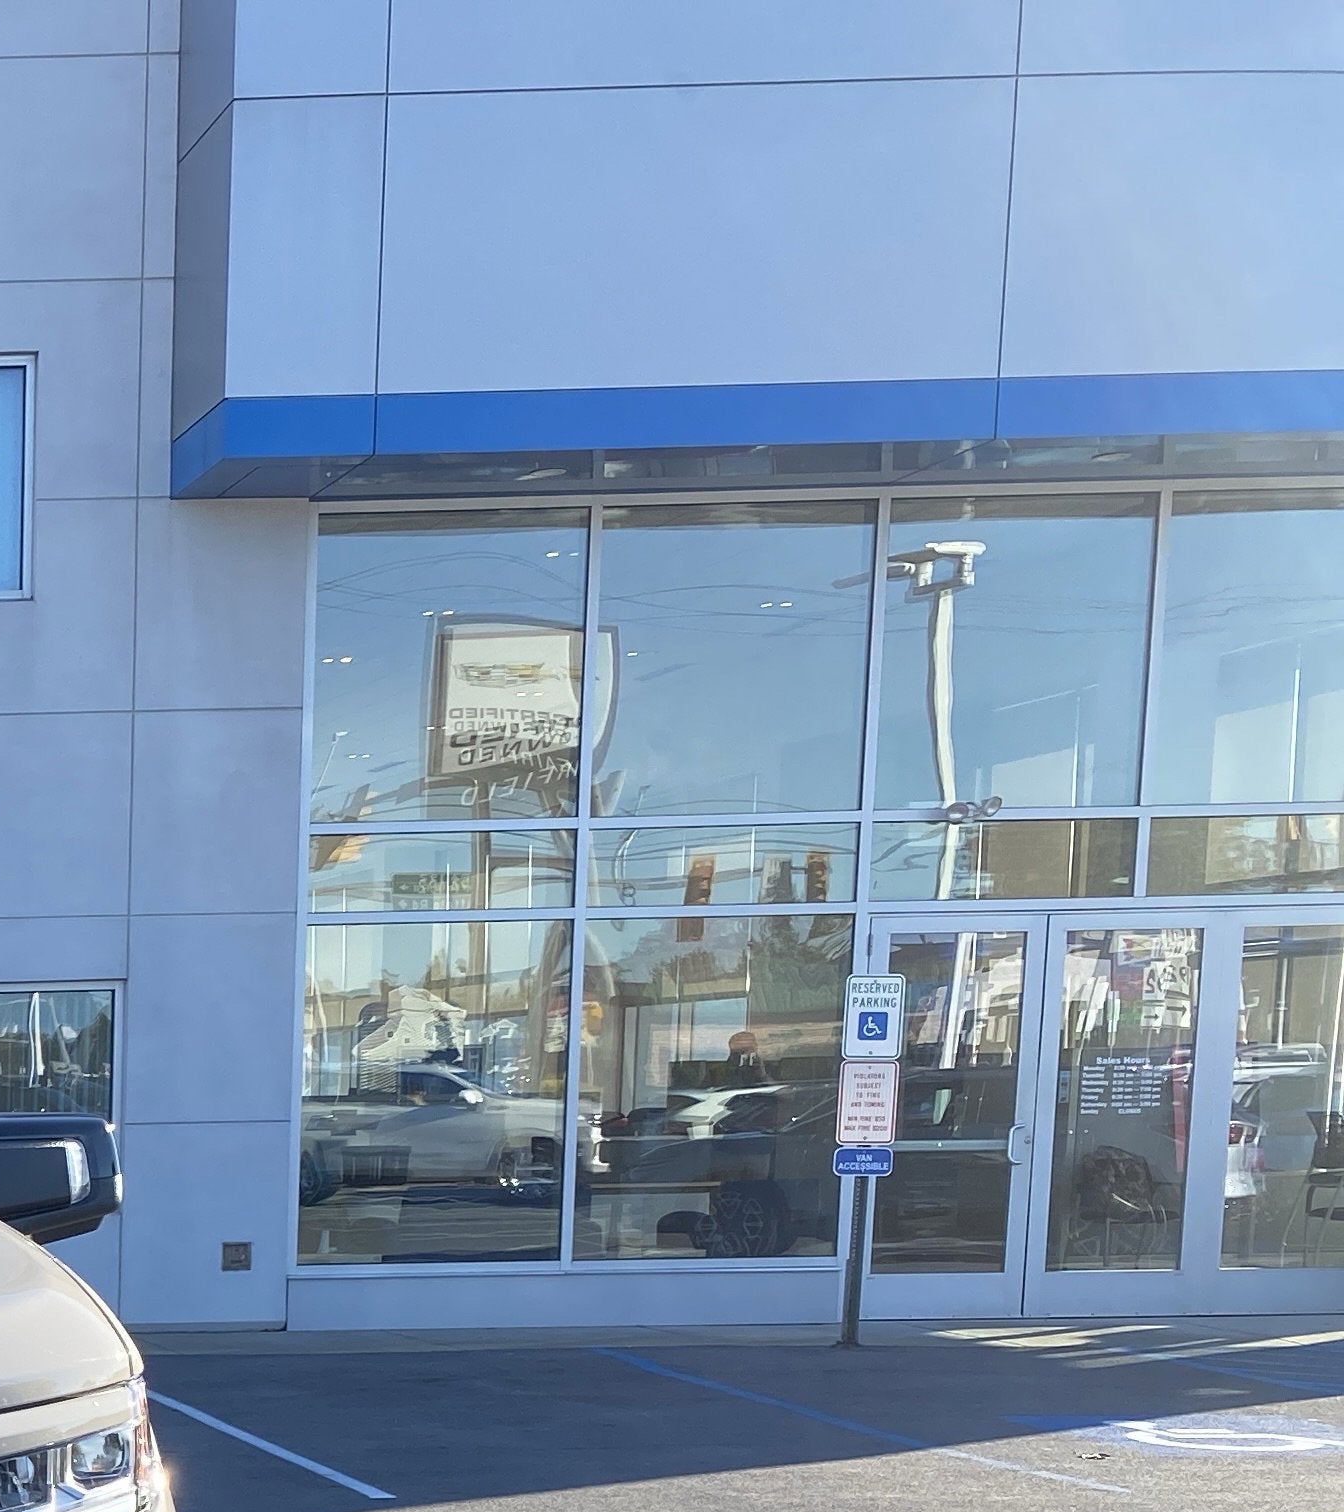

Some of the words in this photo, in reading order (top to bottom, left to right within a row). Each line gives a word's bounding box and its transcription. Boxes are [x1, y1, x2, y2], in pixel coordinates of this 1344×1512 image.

[852, 983, 900, 994] RESERVED
[852, 997, 897, 1008] PARKING
[1096, 1057, 1121, 1065] Sales
[1123, 1056, 1151, 1064] Hours
[837, 1162, 889, 1171] ACCESSIBLE
